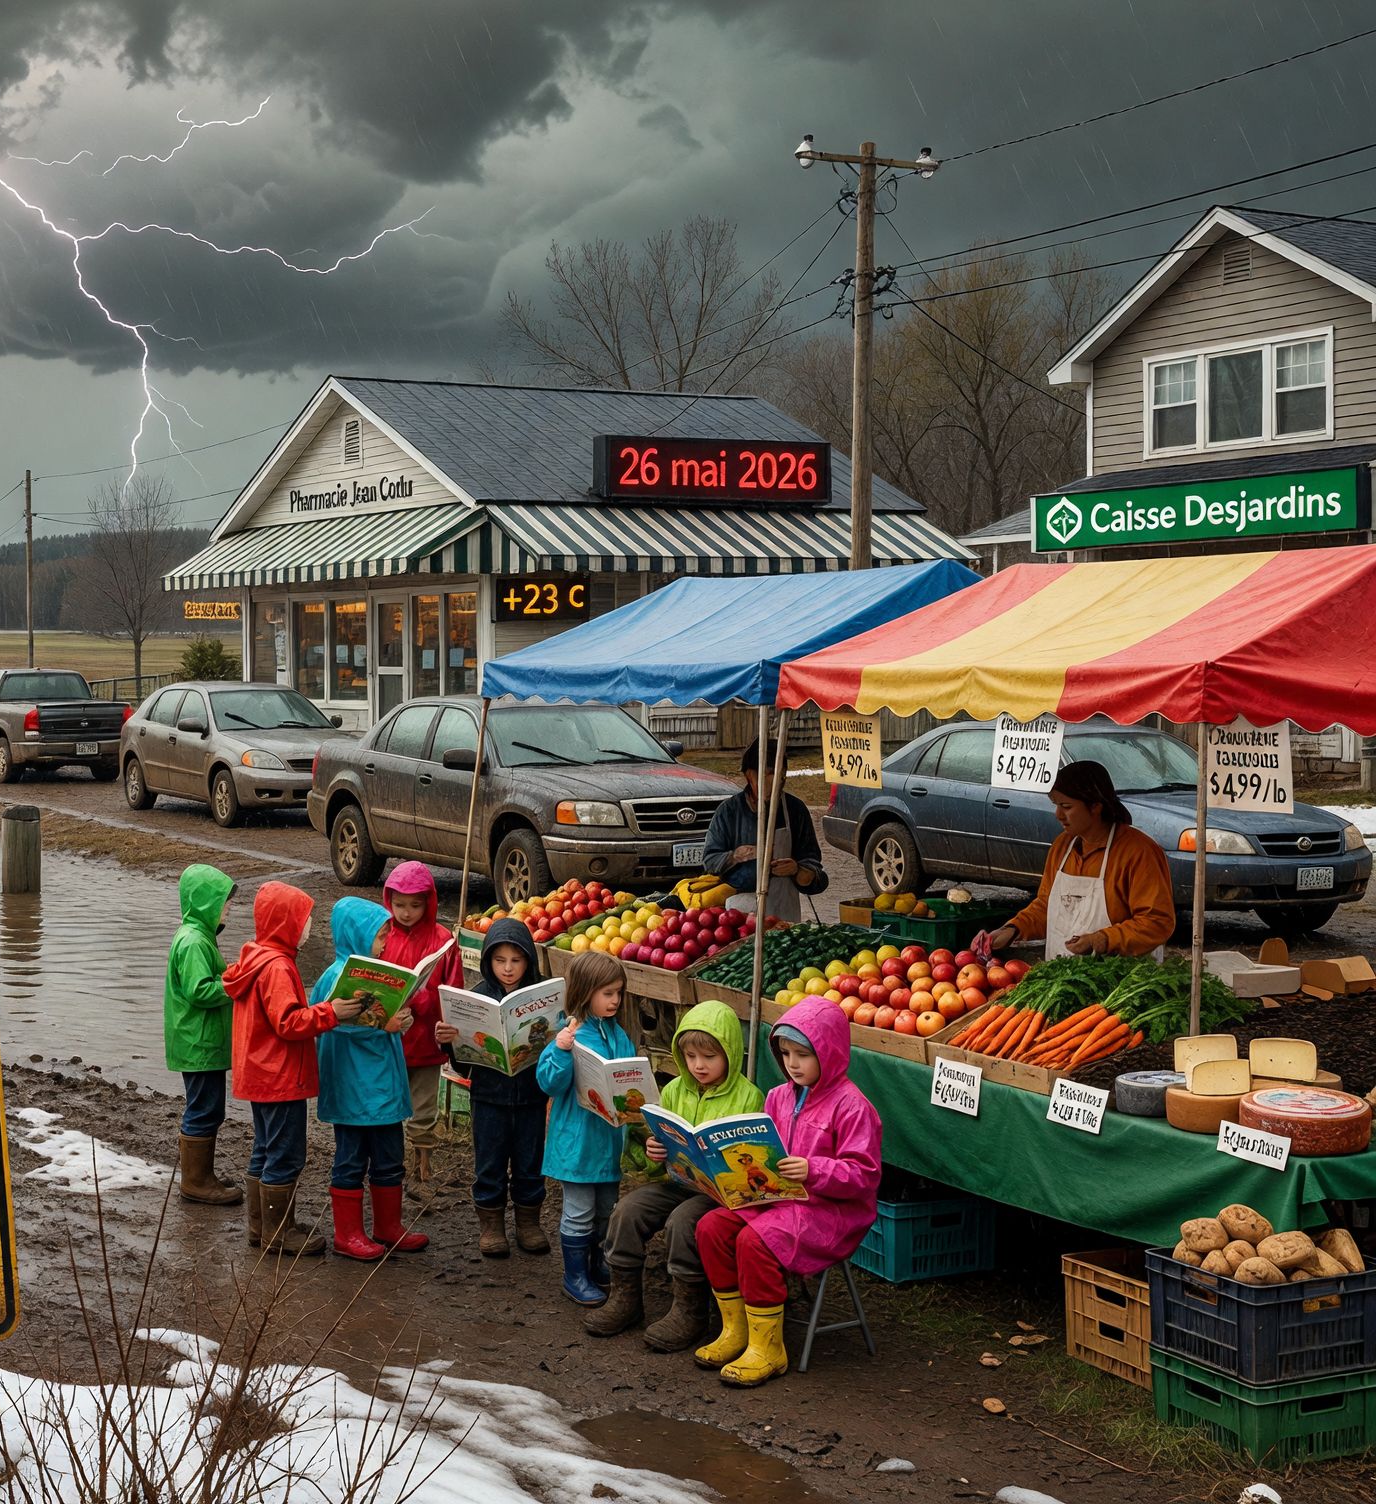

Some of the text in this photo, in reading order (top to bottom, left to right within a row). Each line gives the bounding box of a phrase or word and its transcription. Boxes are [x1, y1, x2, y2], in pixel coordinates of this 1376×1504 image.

[619, 447, 817, 491] 26 mai 2026
[1090, 485, 1342, 533] Caisse Desjardins
[503, 583, 585, 614] +23 C
